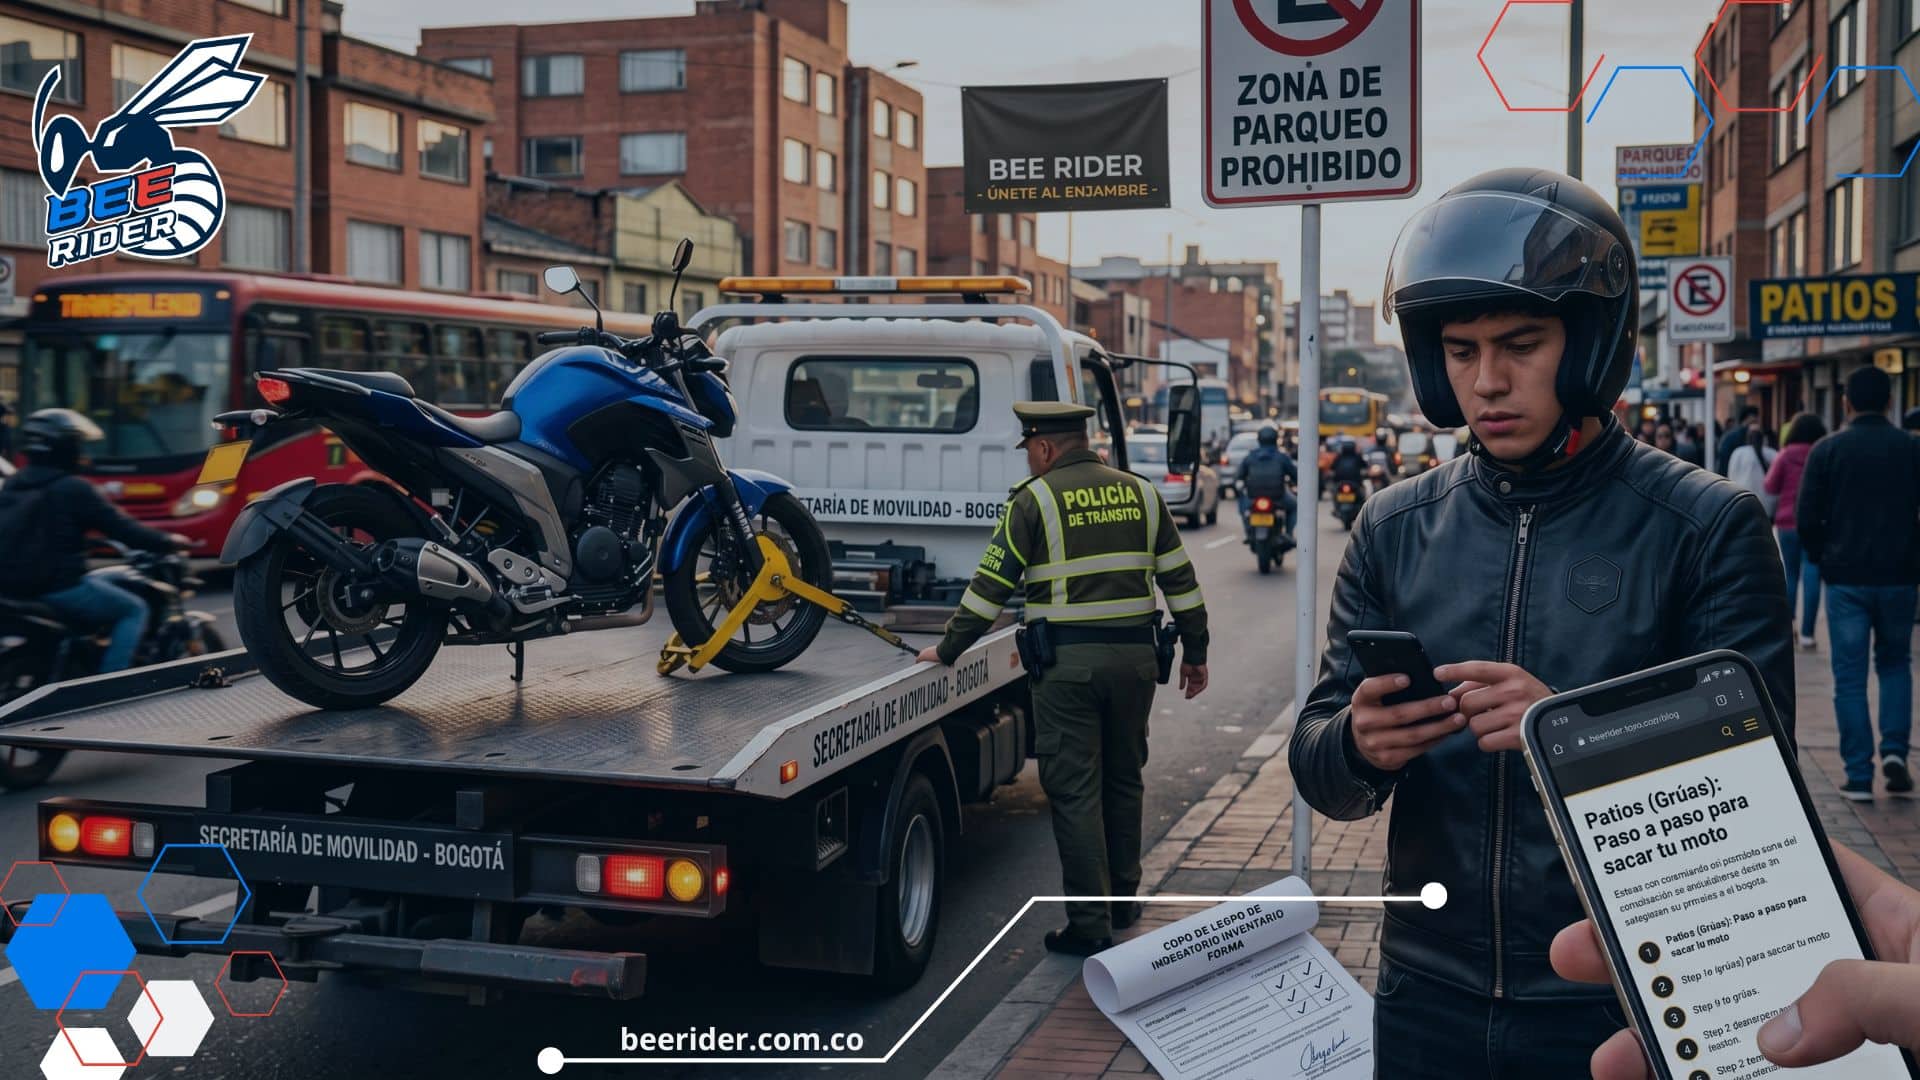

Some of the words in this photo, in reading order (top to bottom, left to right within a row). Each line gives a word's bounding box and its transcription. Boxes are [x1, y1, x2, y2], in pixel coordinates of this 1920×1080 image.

[1237, 69, 1329, 106] ZONA
[1339, 65, 1382, 99] DE
[1233, 106, 1388, 146] PARQUEO
[989, 157, 1045, 181] BEE
[1054, 154, 1143, 179] RIDER
[1221, 147, 1401, 187] PROHIBIDO
[987, 185, 1037, 200] ÚNETE
[1041, 186, 1060, 199] AL
[1065, 184, 1148, 199] ENJAMBRE
[1760, 278, 1898, 324] PATIOS
[799, 491, 847, 515] TARÍA
[850, 498, 869, 516] DE
[873, 500, 951, 518] MOVILIDAD
[1062, 482, 1139, 510] POLICÍA
[1068, 513, 1084, 527] DE
[1087, 507, 1142, 525] TRÁNSITO
[813, 701, 881, 768] SECRETARÍA
[884, 698, 897, 733] DE
[900, 675, 949, 724] MOVILIDAD
[956, 650, 989, 697] BOGOTÁ
[1584, 801, 1644, 829] Patios
[1648, 776, 1722, 814] (Grúas):
[1593, 828, 1640, 852] Paso
[1645, 823, 1657, 836] a
[1660, 809, 1704, 836] paso
[1708, 795, 1749, 821] para
[199, 825, 297, 854] SECRETARÍA
[301, 832, 323, 857] DE
[327, 834, 418, 864] MOVILIDAD
[435, 841, 505, 871] BOGOTÁ
[1603, 848, 1653, 875] sacar
[1656, 842, 1677, 858] tu
[1681, 827, 1728, 851] moto
[1163, 933, 1193, 951] COPO
[1194, 926, 1209, 938] DE
[1210, 911, 1245, 931] LEGPO
[1247, 904, 1262, 917] DE
[1221, 909, 1284, 942] INVENTARIO
[1697, 917, 1733, 936] (Grúas):
[1733, 912, 1755, 923] Paso
[1765, 902, 1786, 915] paso
[1787, 895, 1807, 909] para
[1207, 940, 1245, 961] FORMA
[1671, 944, 1695, 957] sacar
[1707, 934, 1730, 946] moto
[1681, 973, 1702, 985] Step
[1746, 952, 1765, 966] para
[1796, 939, 1806, 948] tu
[1807, 931, 1830, 944] moto
[1692, 1002, 1713, 1015] Step
[1703, 1028, 1724, 1040] Step
[1716, 1063, 1737, 1075] Step
